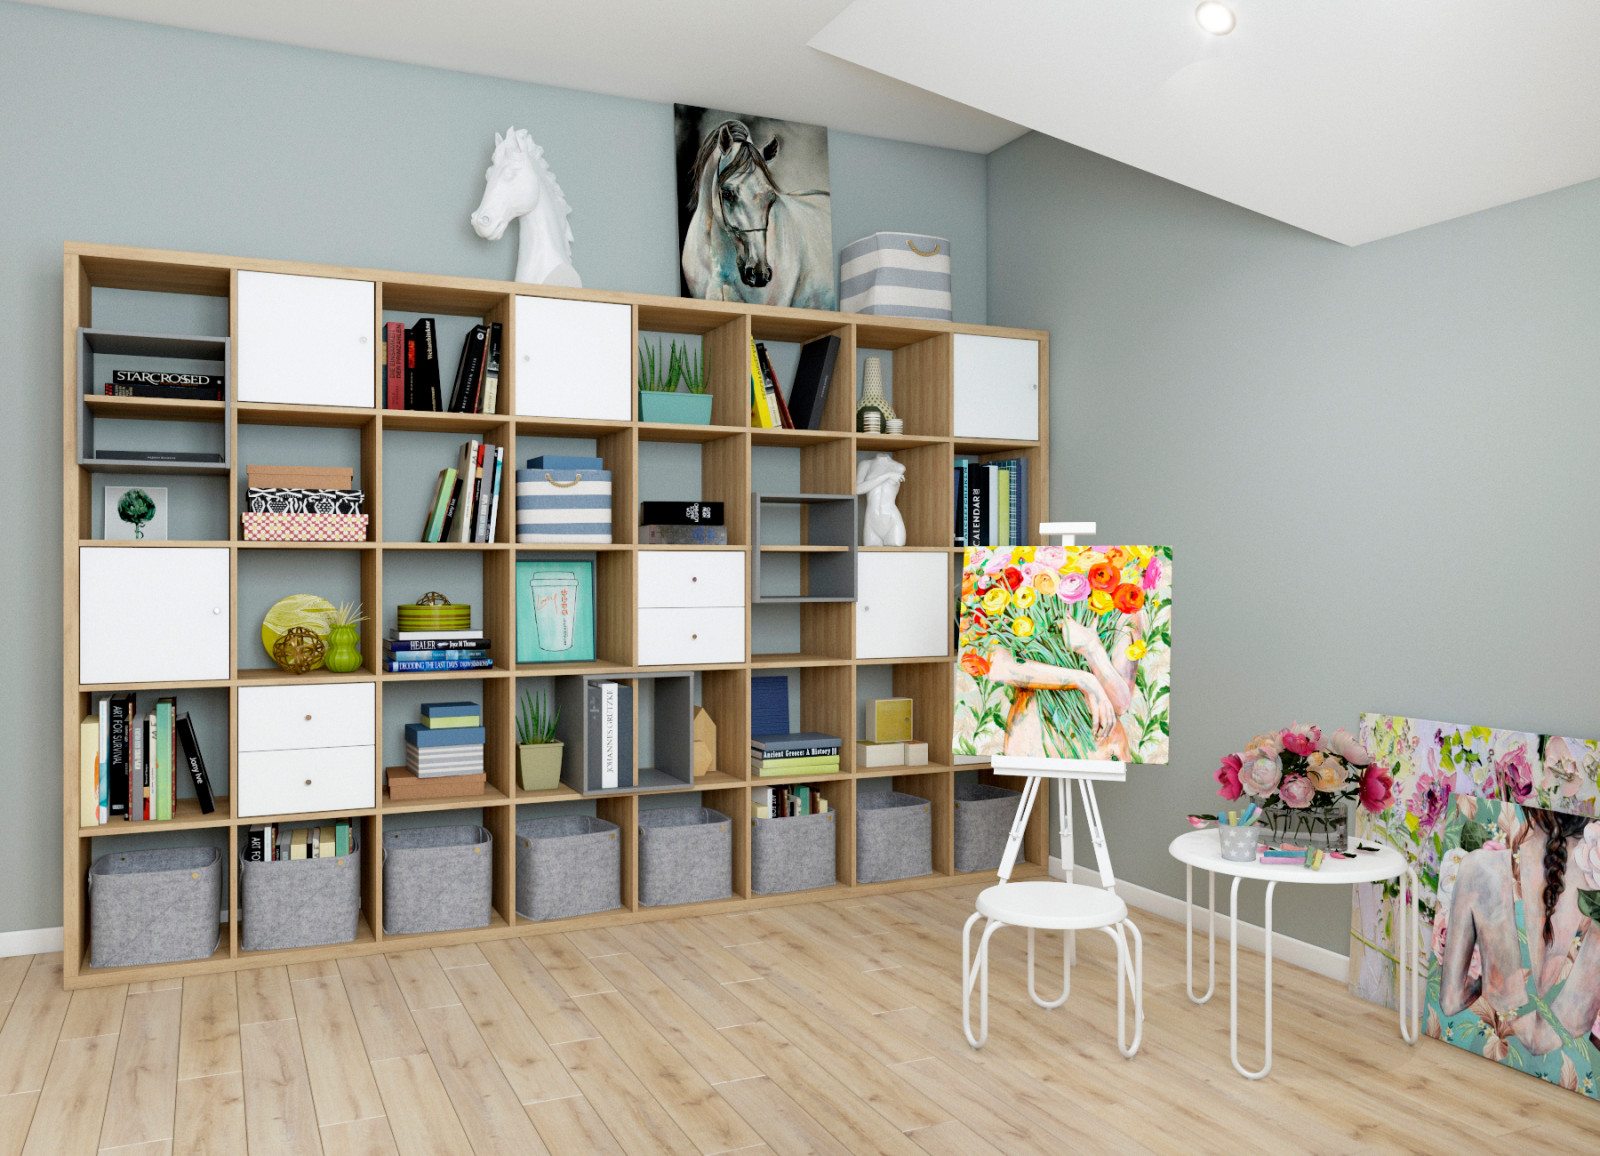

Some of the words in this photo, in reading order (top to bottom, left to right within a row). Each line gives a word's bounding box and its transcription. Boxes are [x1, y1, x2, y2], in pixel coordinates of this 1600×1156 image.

[116, 371, 210, 385] STARCROSSED
[972, 495, 980, 547] CALENDAR
[410, 640, 436, 650] HEALER
[425, 660, 435, 669] THE
[435, 660, 446, 669] LAST
[112, 705, 123, 718] ART
[112, 719, 122, 735] FOR
[112, 735, 122, 765] SURVIVAL
[606, 729, 614, 773] JOHANNES
[763, 750, 784, 758] Ancient
[805, 748, 810, 756] A
[811, 747, 831, 756] History
[189, 757, 199, 773] Jony
[251, 837, 261, 849] ART
